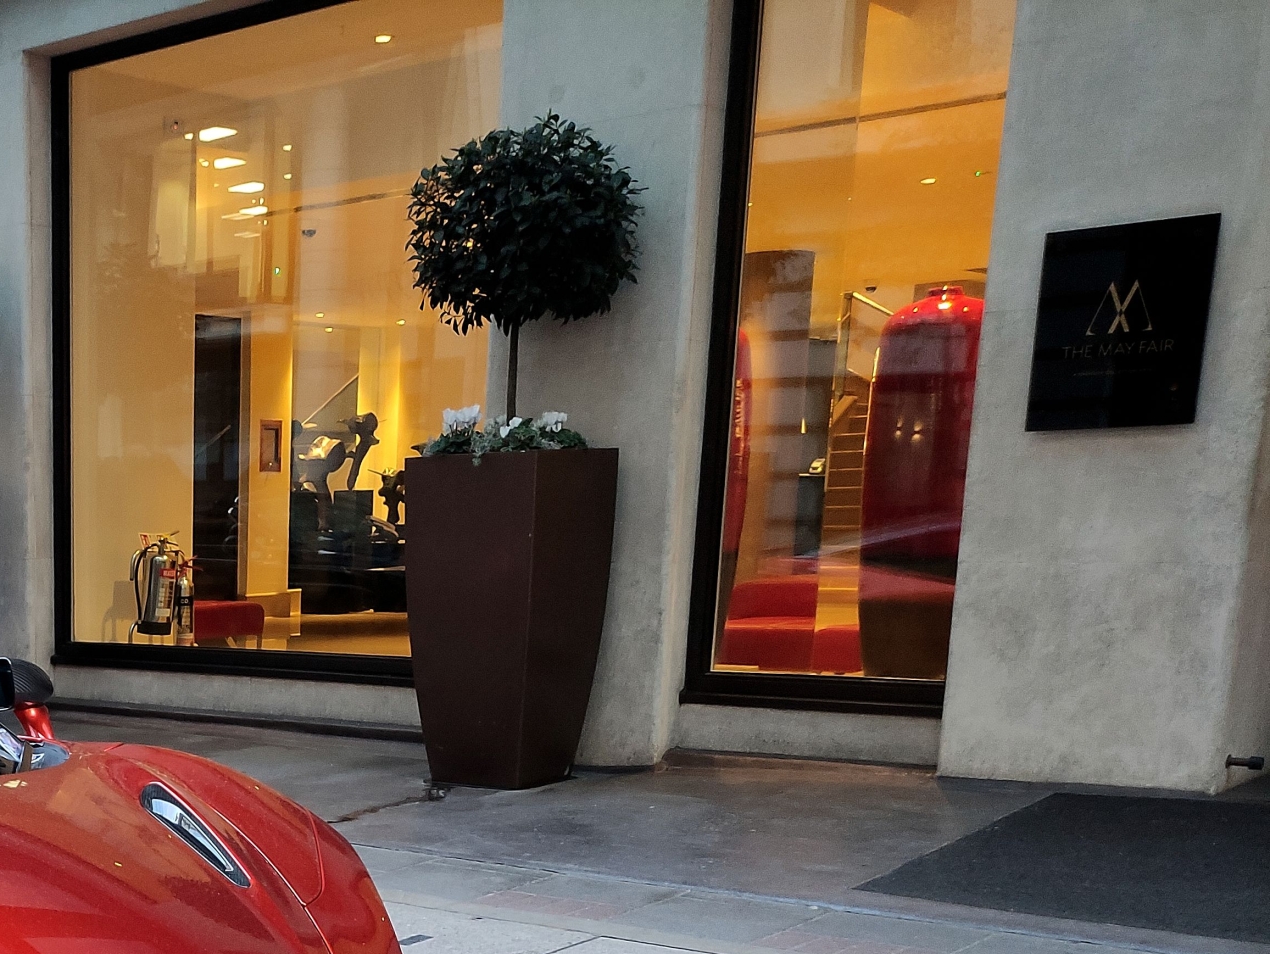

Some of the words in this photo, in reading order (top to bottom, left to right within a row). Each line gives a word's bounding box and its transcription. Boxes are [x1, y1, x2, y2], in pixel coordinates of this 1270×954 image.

[1061, 343, 1094, 360] THE
[1097, 341, 1136, 358] MAY
[1138, 338, 1176, 355] FAIR
